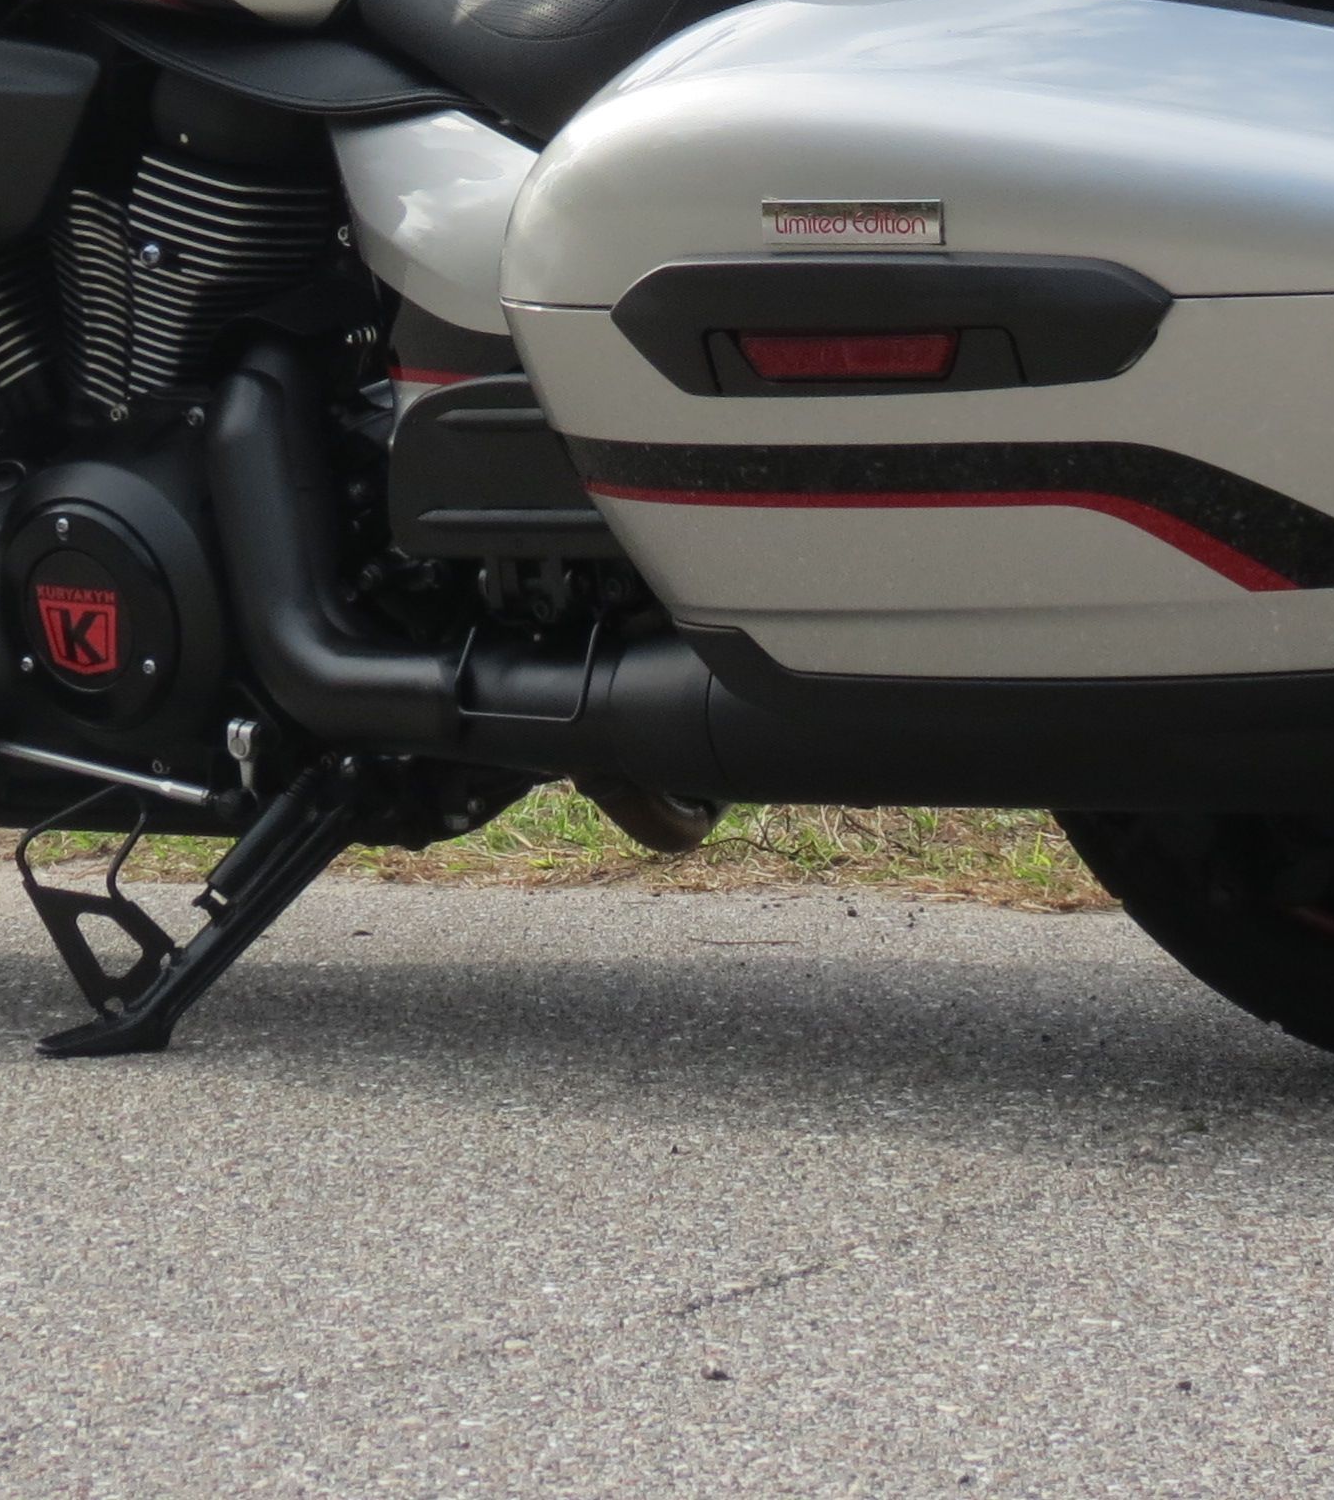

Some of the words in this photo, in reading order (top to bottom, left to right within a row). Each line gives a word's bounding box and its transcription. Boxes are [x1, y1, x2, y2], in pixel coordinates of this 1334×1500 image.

[775, 211, 847, 235] Limited
[854, 212, 926, 235] Edition
[60, 608, 107, 664] K
